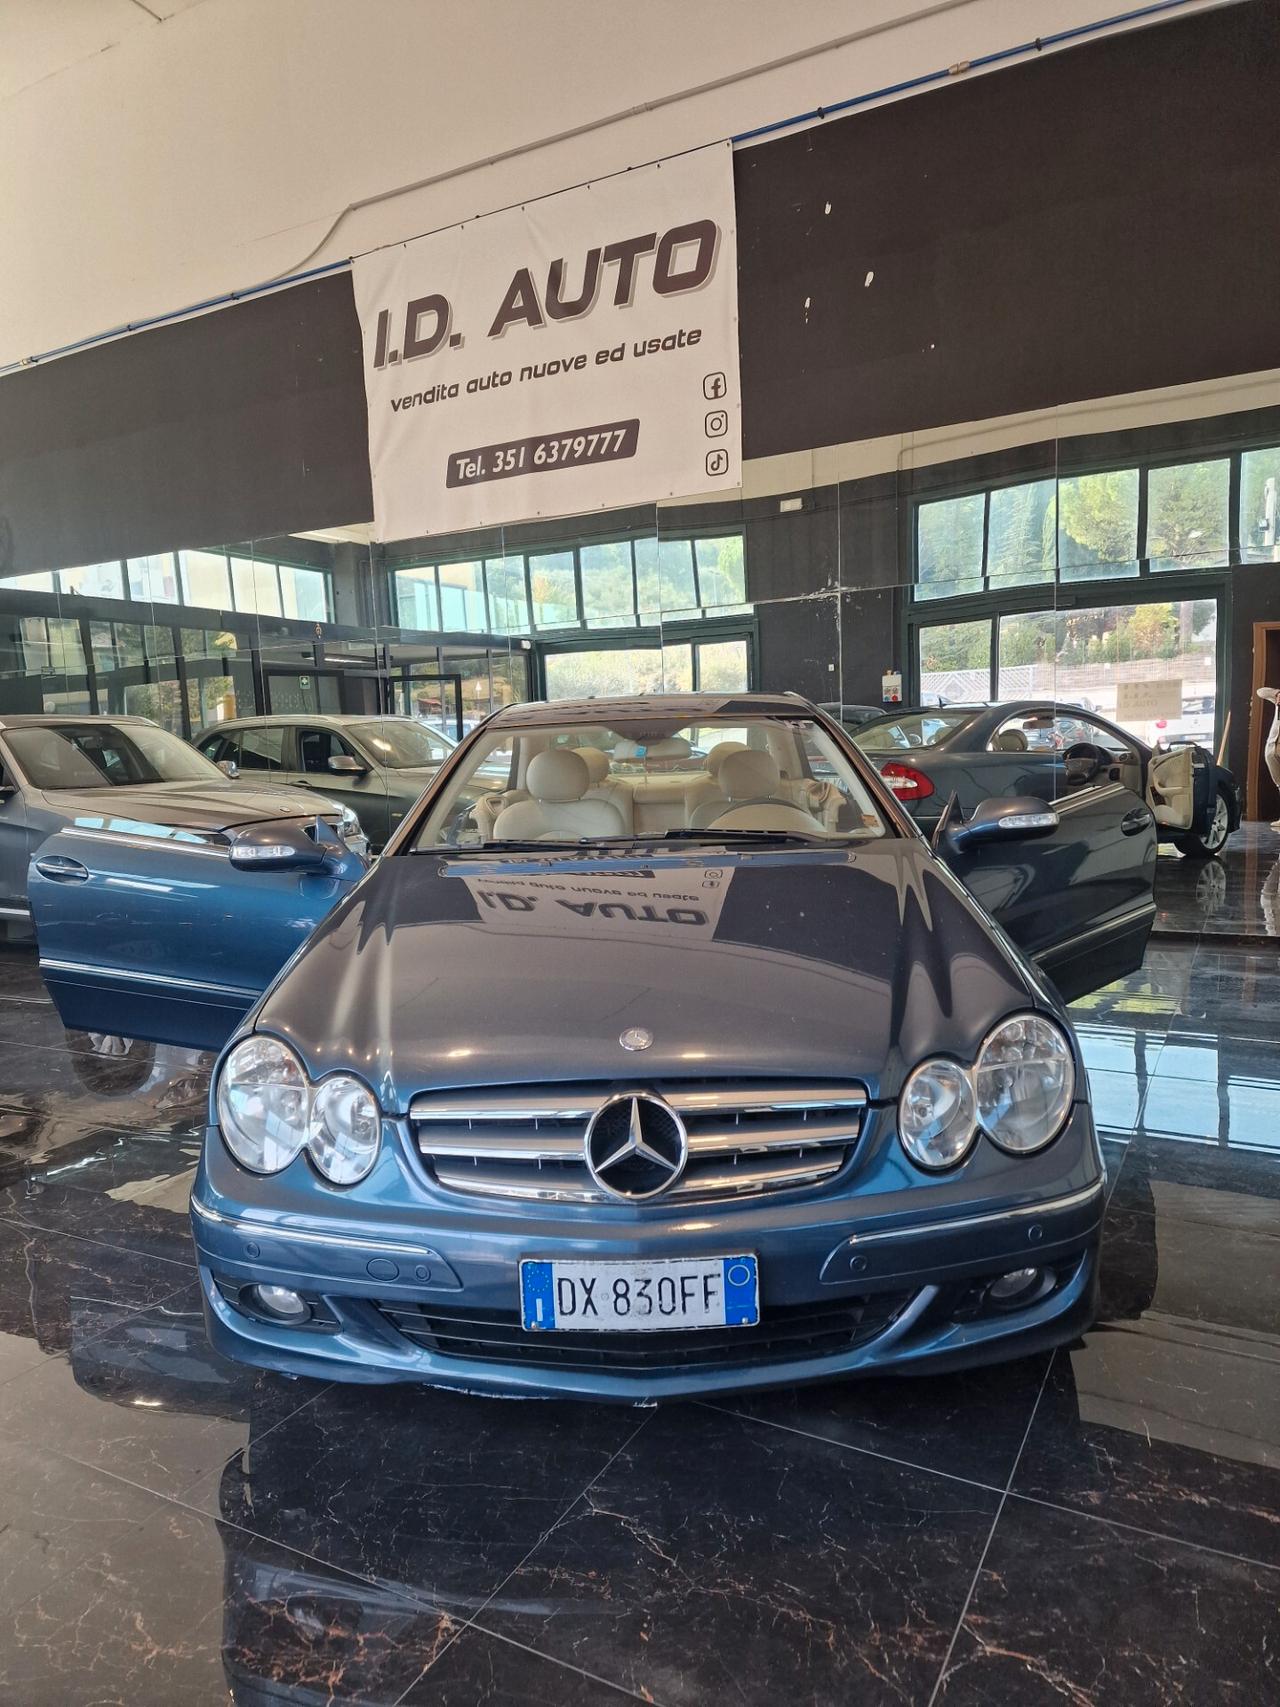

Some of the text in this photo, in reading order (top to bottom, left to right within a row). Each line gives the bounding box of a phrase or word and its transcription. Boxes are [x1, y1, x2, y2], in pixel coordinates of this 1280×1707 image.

[373, 219, 722, 369] I.D. AUTO
[391, 327, 702, 412] vendita auto nuove ed usate
[456, 429, 627, 480] Tel. 351 6379777
[557, 1277, 598, 1316] DX
